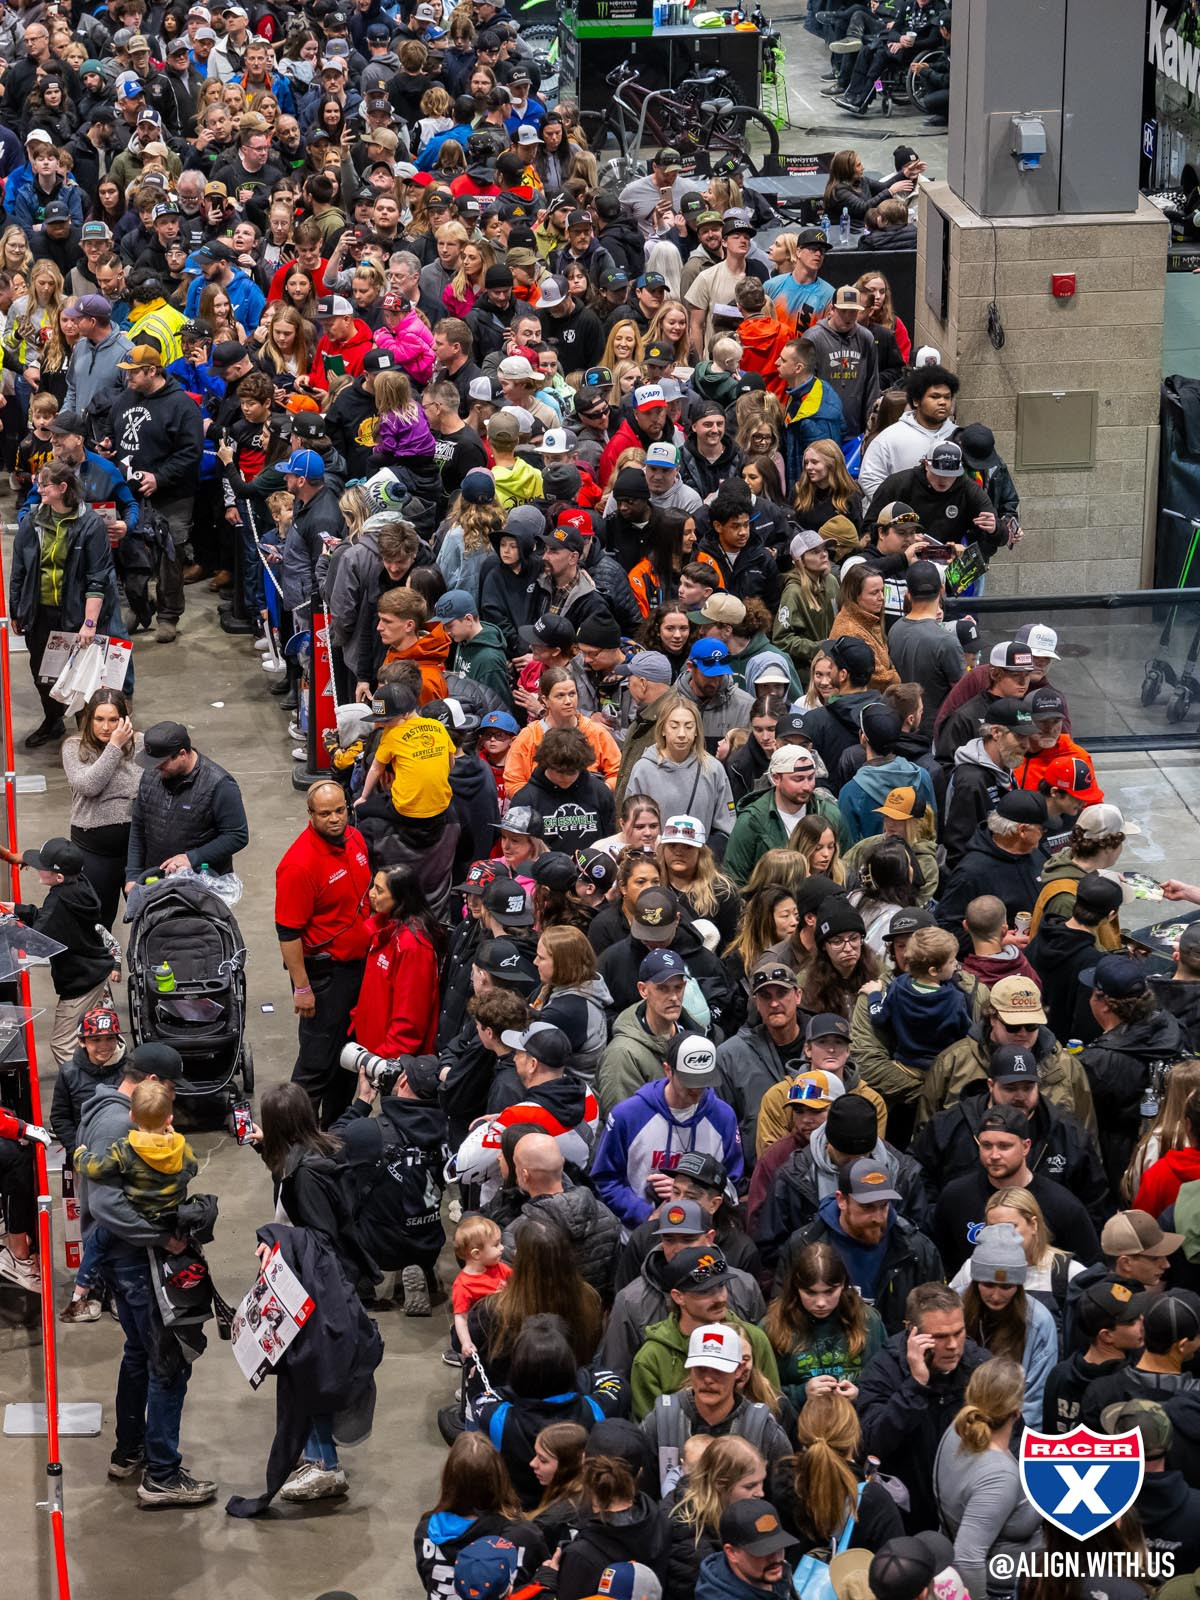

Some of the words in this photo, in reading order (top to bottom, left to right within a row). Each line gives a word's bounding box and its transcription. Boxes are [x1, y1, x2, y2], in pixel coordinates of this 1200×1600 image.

[543, 813, 596, 828] CRESWELL
[543, 823, 597, 835] TIGERS
[98, 1018, 111, 1030] 18
[686, 1054, 712, 1064] FMF
